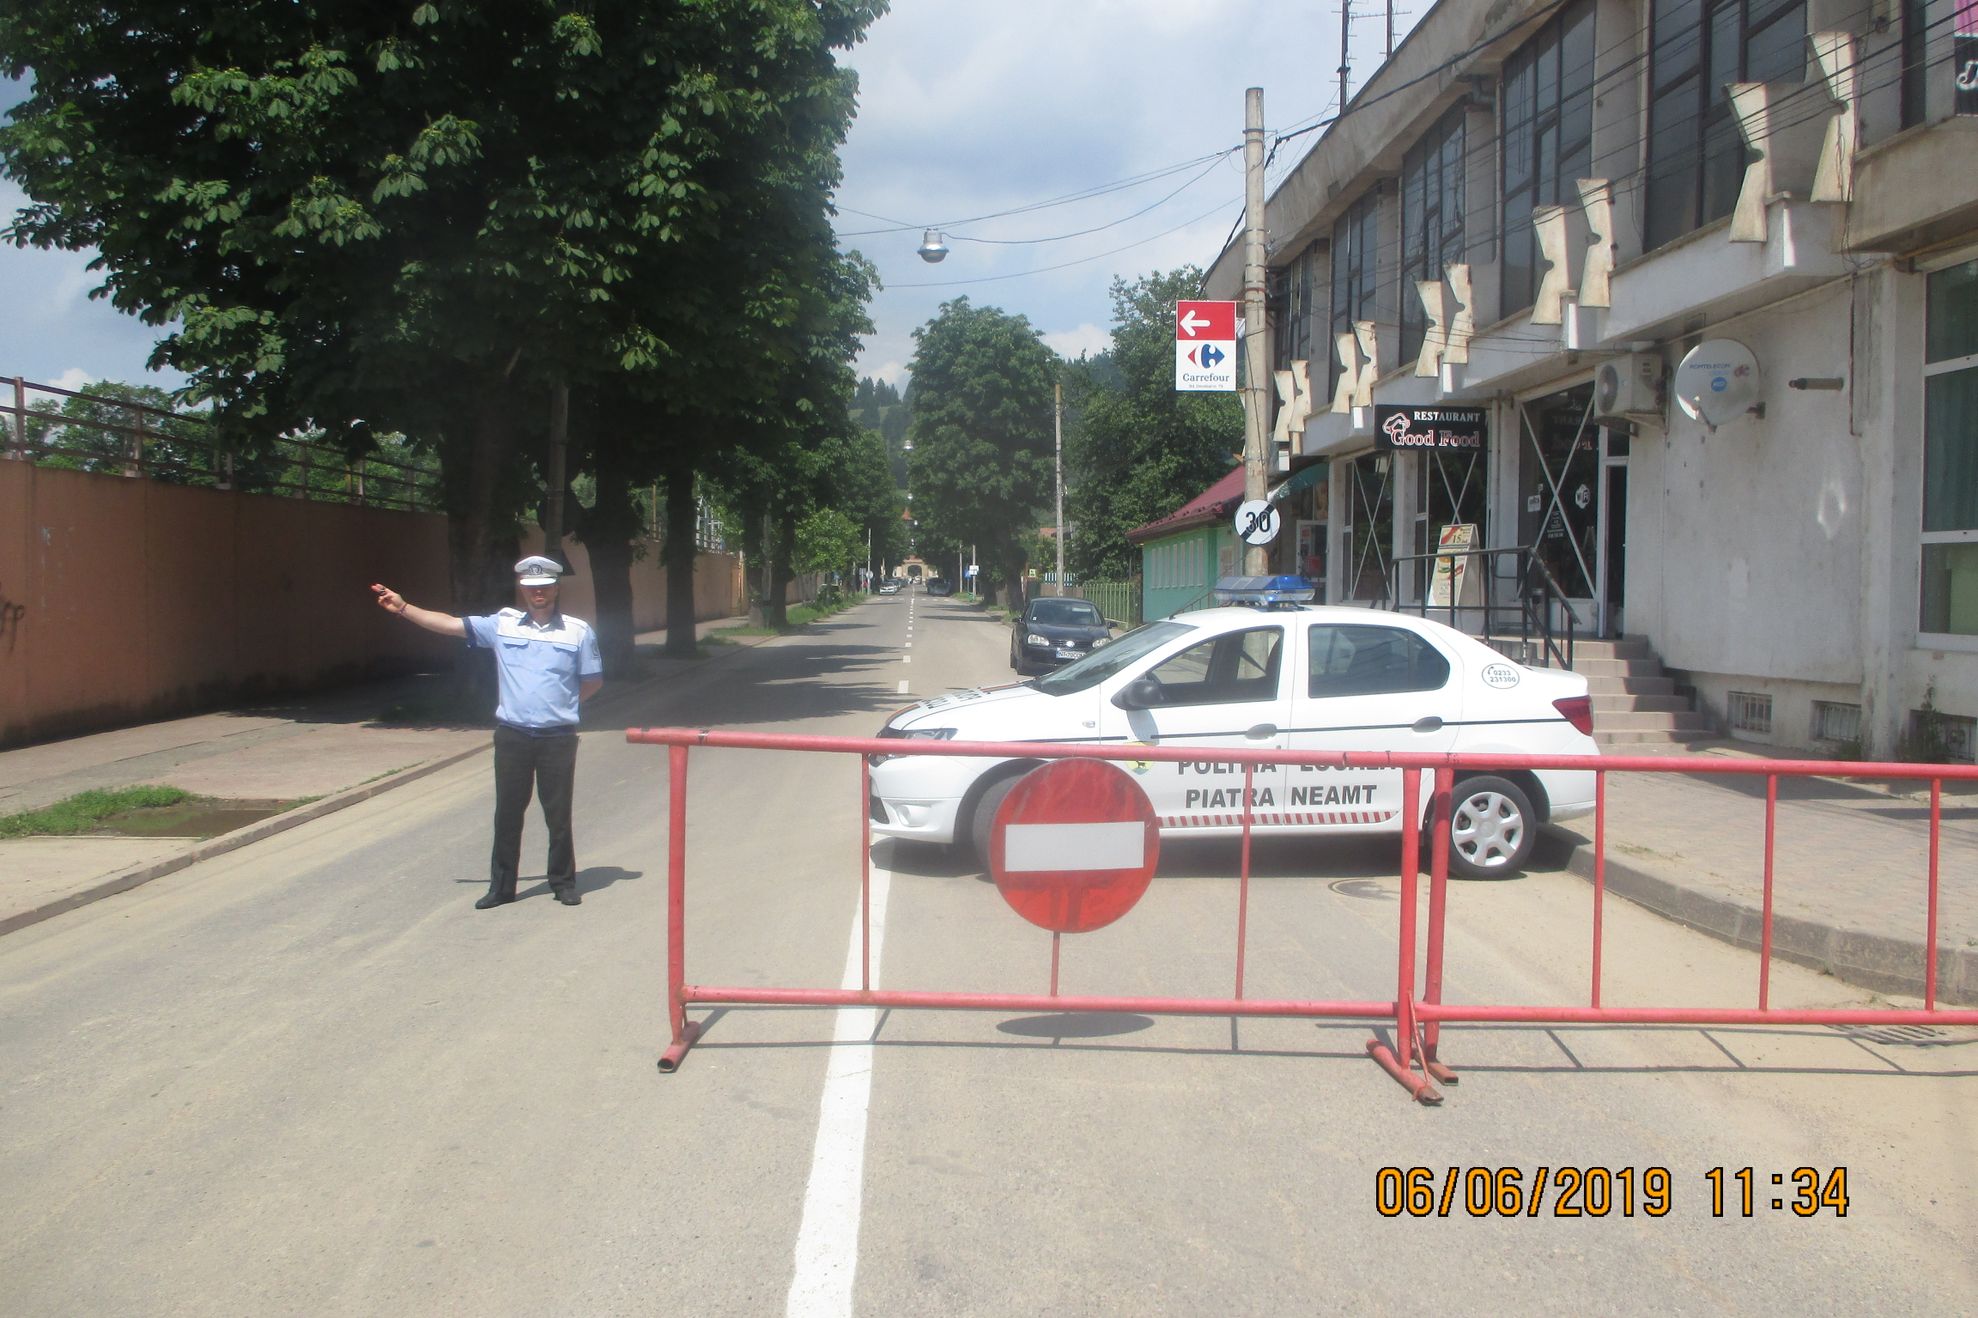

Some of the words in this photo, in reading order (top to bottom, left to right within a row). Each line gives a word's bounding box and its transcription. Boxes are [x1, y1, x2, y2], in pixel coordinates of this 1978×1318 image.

[1182, 372, 1230, 382] Carrefour
[1413, 411, 1480, 422] RESTAURANT
[1391, 429, 1435, 447] Good
[1439, 430, 1480, 447] Food
[1246, 511, 1271, 534] 30
[1185, 787, 1275, 809] PIATRA
[1290, 784, 1378, 806] NEAMT
